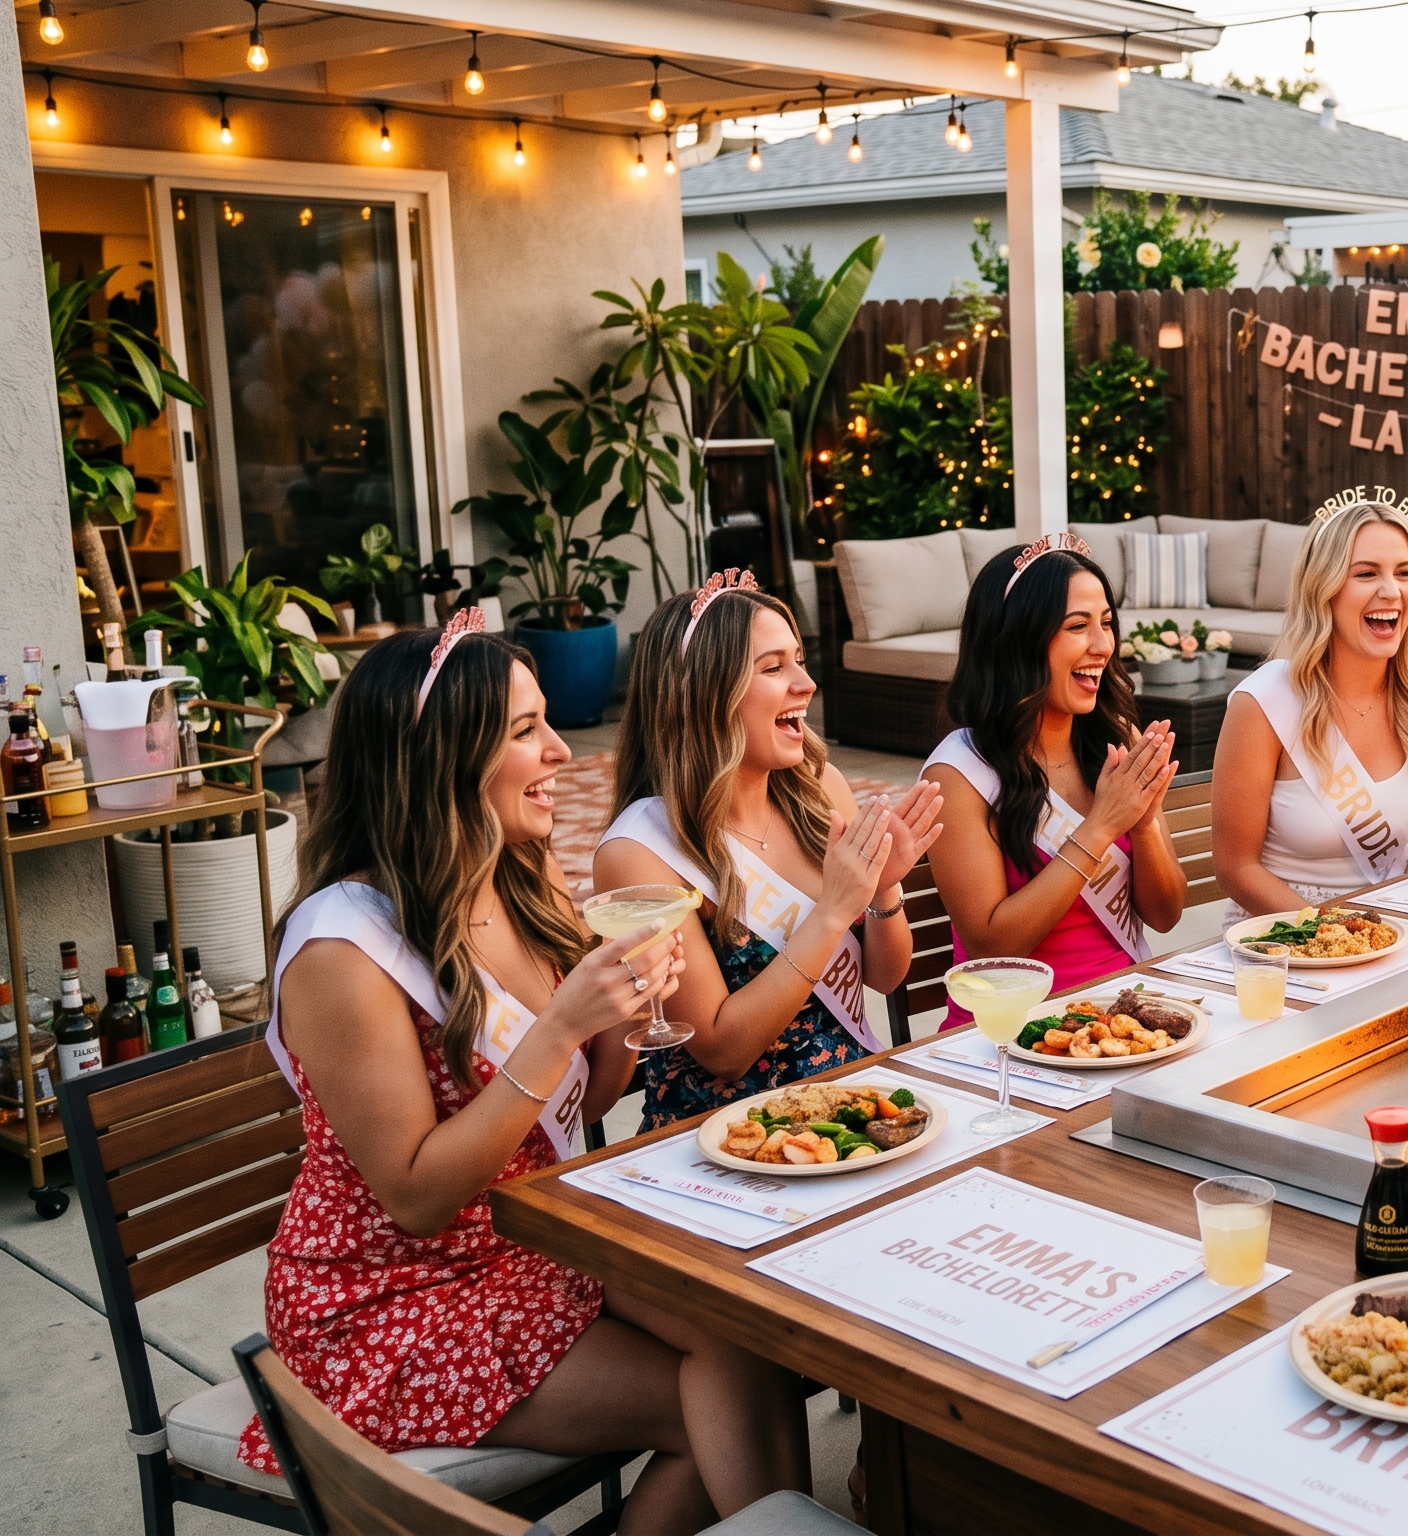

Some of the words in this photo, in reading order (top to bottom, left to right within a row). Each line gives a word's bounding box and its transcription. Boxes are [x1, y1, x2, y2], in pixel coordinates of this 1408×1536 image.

[1374, 485, 1396, 505] TO
[1326, 763, 1399, 869] BRIDE
[743, 864, 802, 942] TEA
[884, 1238, 1100, 1327] BACHELORETT
[947, 1223, 1138, 1299] EMMA'S
